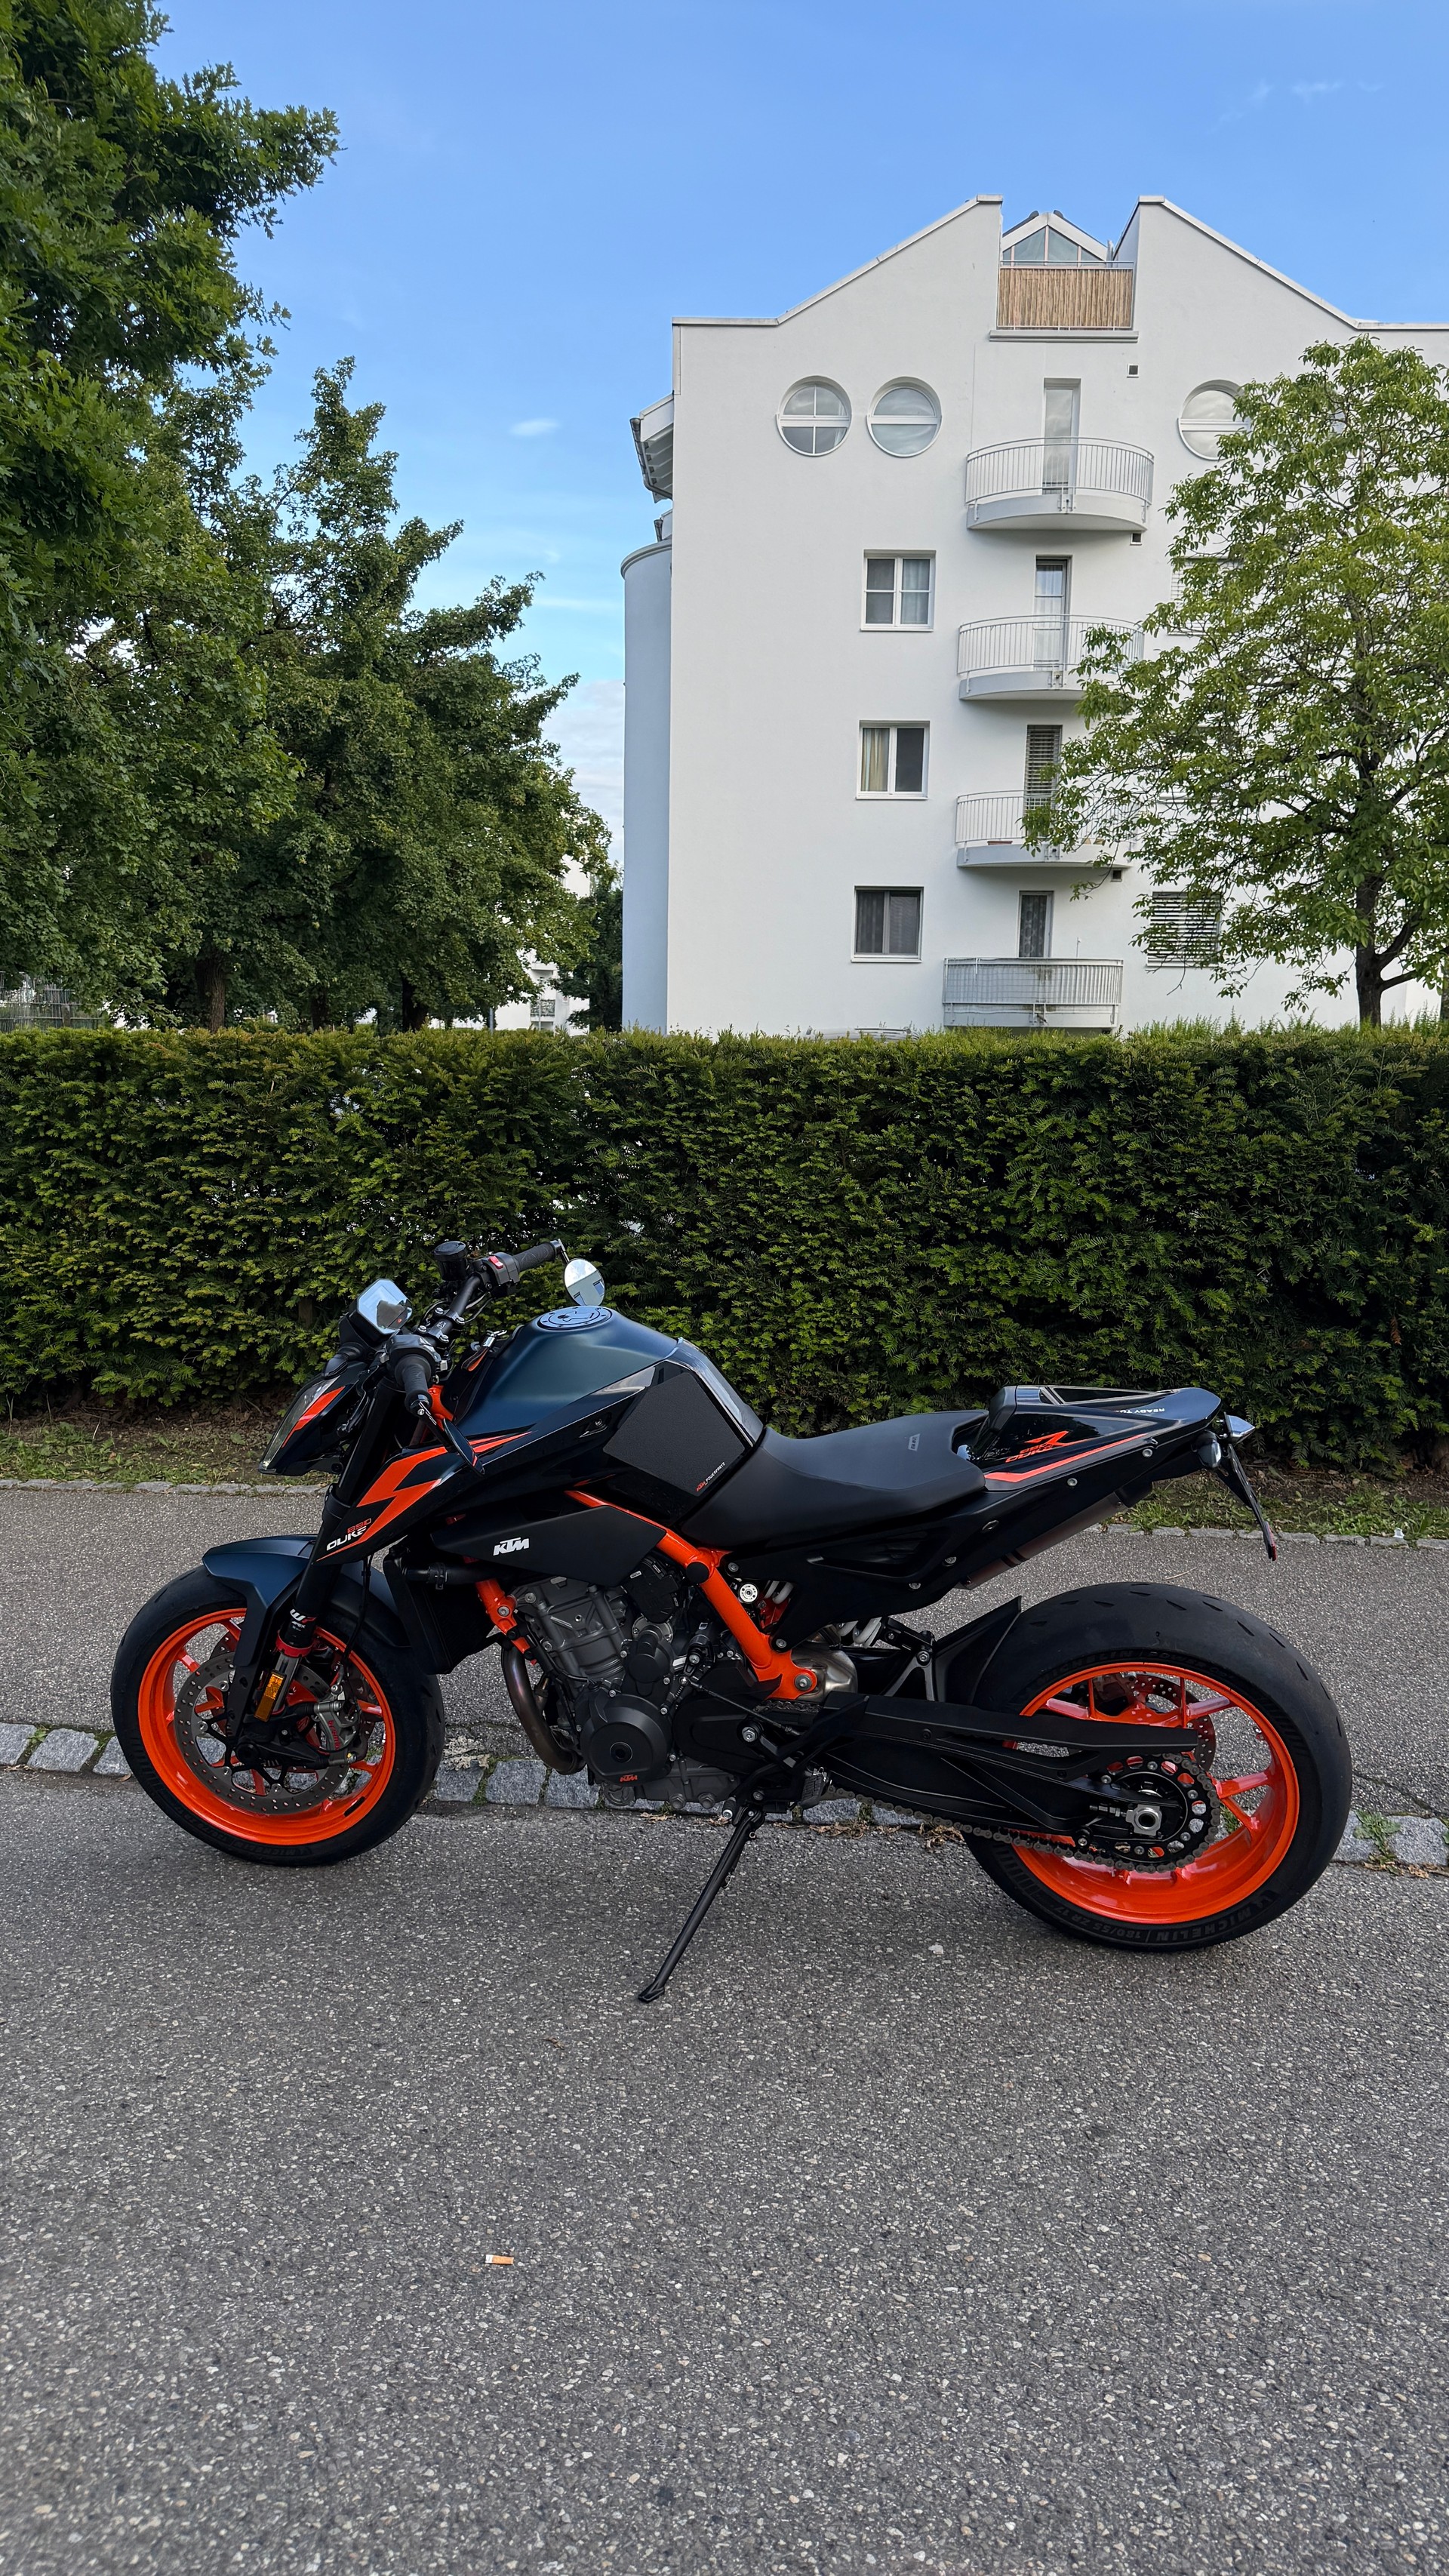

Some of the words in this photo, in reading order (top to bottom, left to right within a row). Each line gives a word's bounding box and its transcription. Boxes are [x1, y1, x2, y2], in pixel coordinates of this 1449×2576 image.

[346, 1518, 372, 1534] 890
[326, 1525, 367, 1551] DUKE
[493, 1537, 530, 1556] KTM
[620, 1774, 638, 1783] KTM
[1091, 1922, 1141, 1939] 180/55
[1155, 1906, 1254, 1942] MICHELIN
